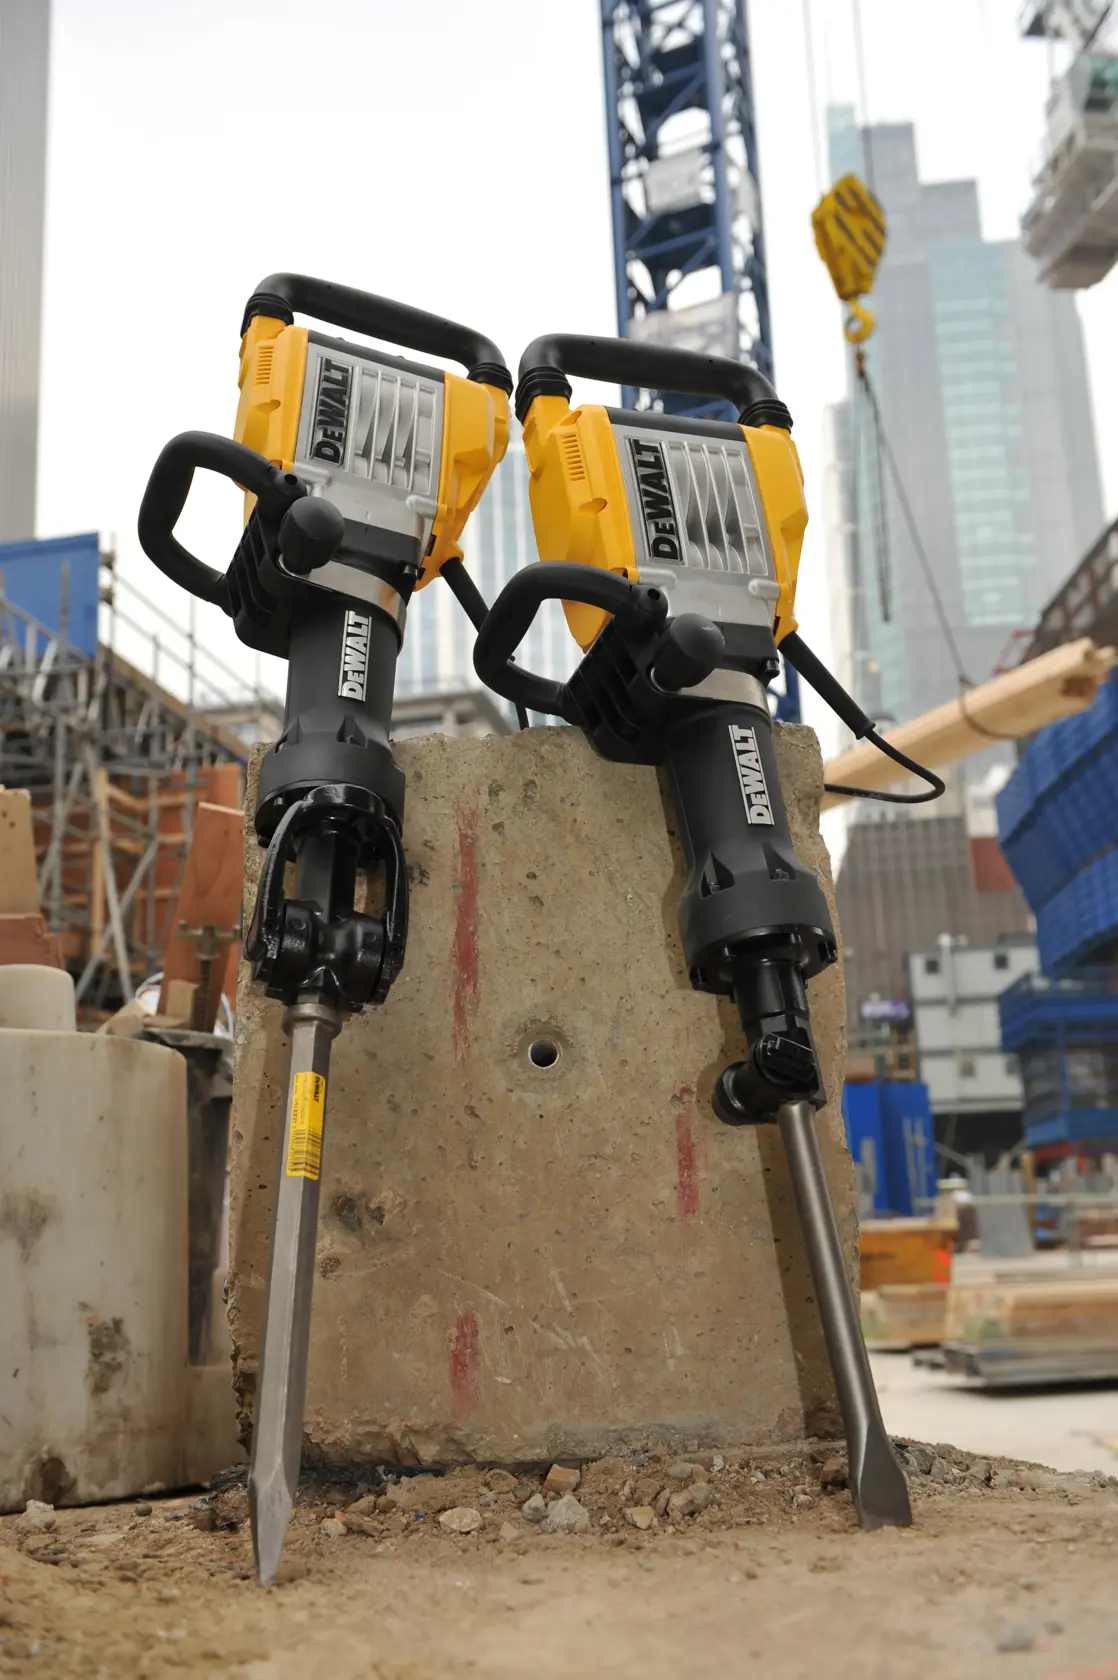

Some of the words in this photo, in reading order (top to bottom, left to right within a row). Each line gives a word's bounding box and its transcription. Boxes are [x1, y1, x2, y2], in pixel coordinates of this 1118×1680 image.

[313, 357, 350, 464] DEWALT
[632, 438, 679, 560] DEWALT
[341, 610, 369, 701] DEWALT
[731, 724, 772, 825] DEWALT
